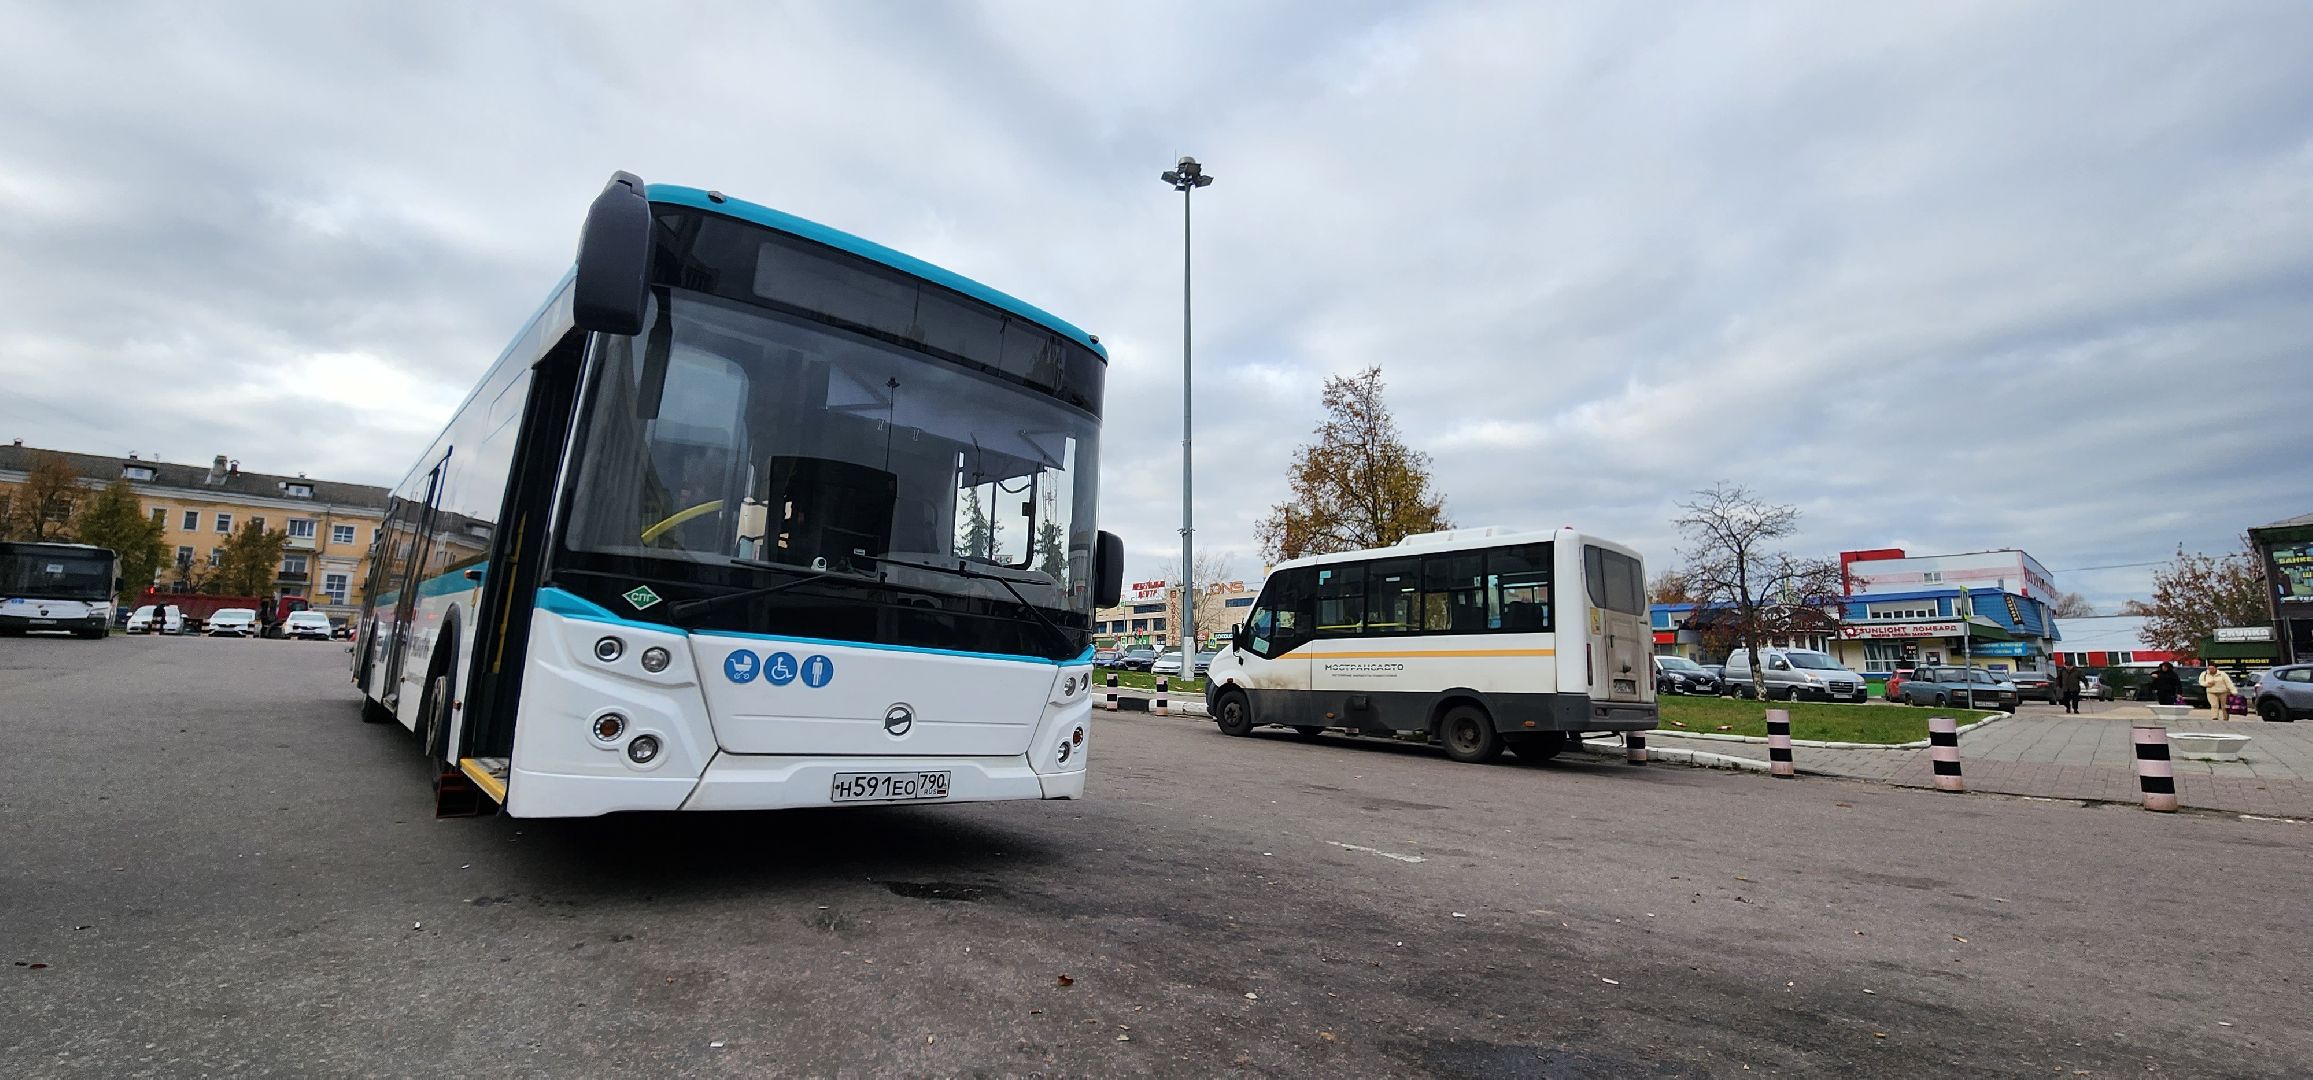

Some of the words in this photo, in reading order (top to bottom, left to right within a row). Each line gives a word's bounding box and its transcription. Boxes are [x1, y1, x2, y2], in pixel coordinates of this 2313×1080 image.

[1209, 581, 1245, 595] DNS
[631, 592, 652, 602] СПГ
[1325, 663, 1404, 671] МОСТРАНСАВТО
[839, 776, 916, 797] Н591ЕО
[919, 773, 945, 789] 790
